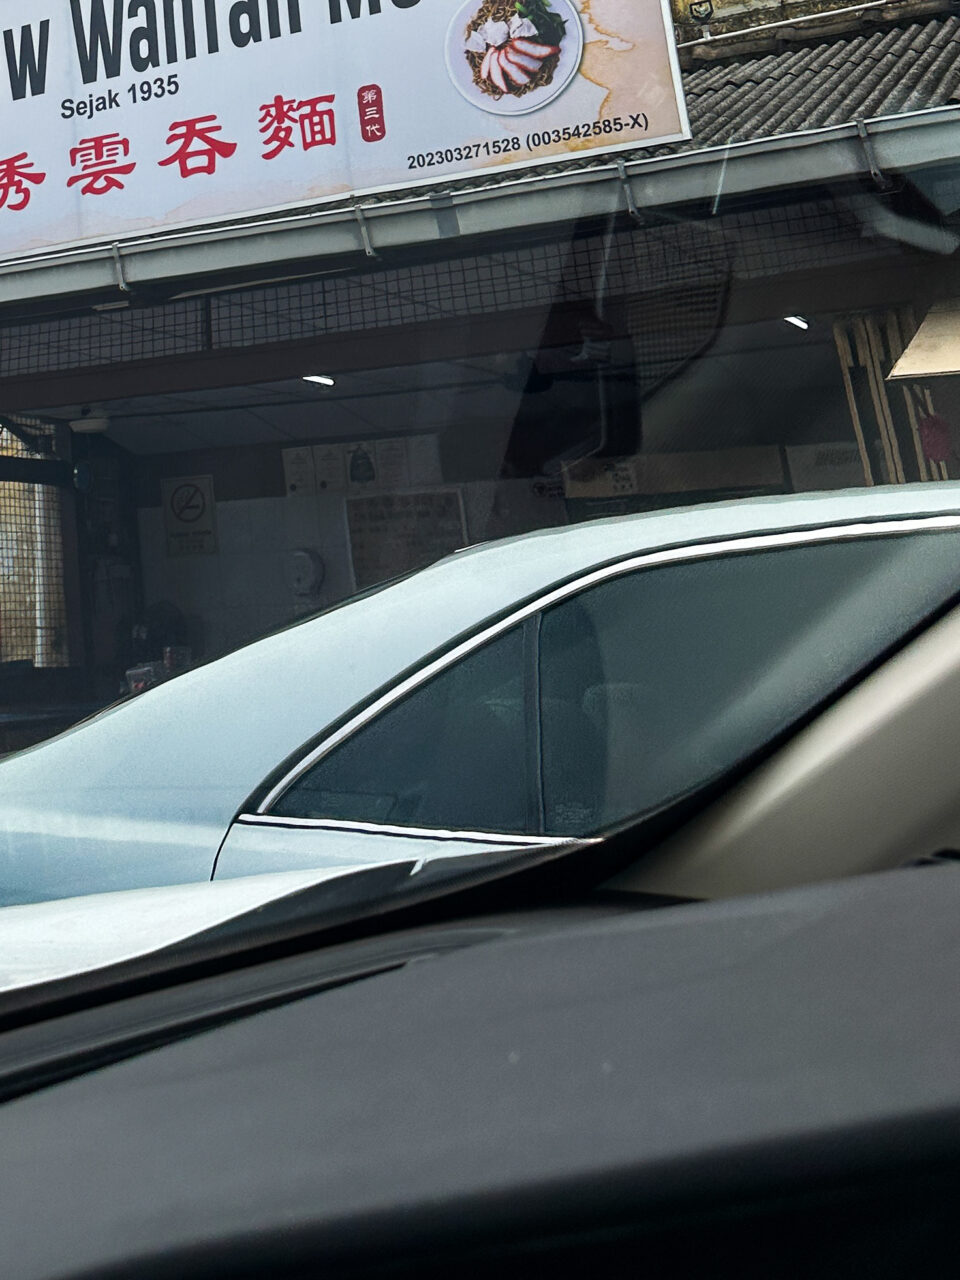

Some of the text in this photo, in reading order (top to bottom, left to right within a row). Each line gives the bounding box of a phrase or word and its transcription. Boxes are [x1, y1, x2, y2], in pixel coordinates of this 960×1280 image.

[60, 73, 180, 120] Sejak 1935
[361, 89, 382, 137] 第三代
[407, 112, 650, 170] 202303271528 (003542585-X)
